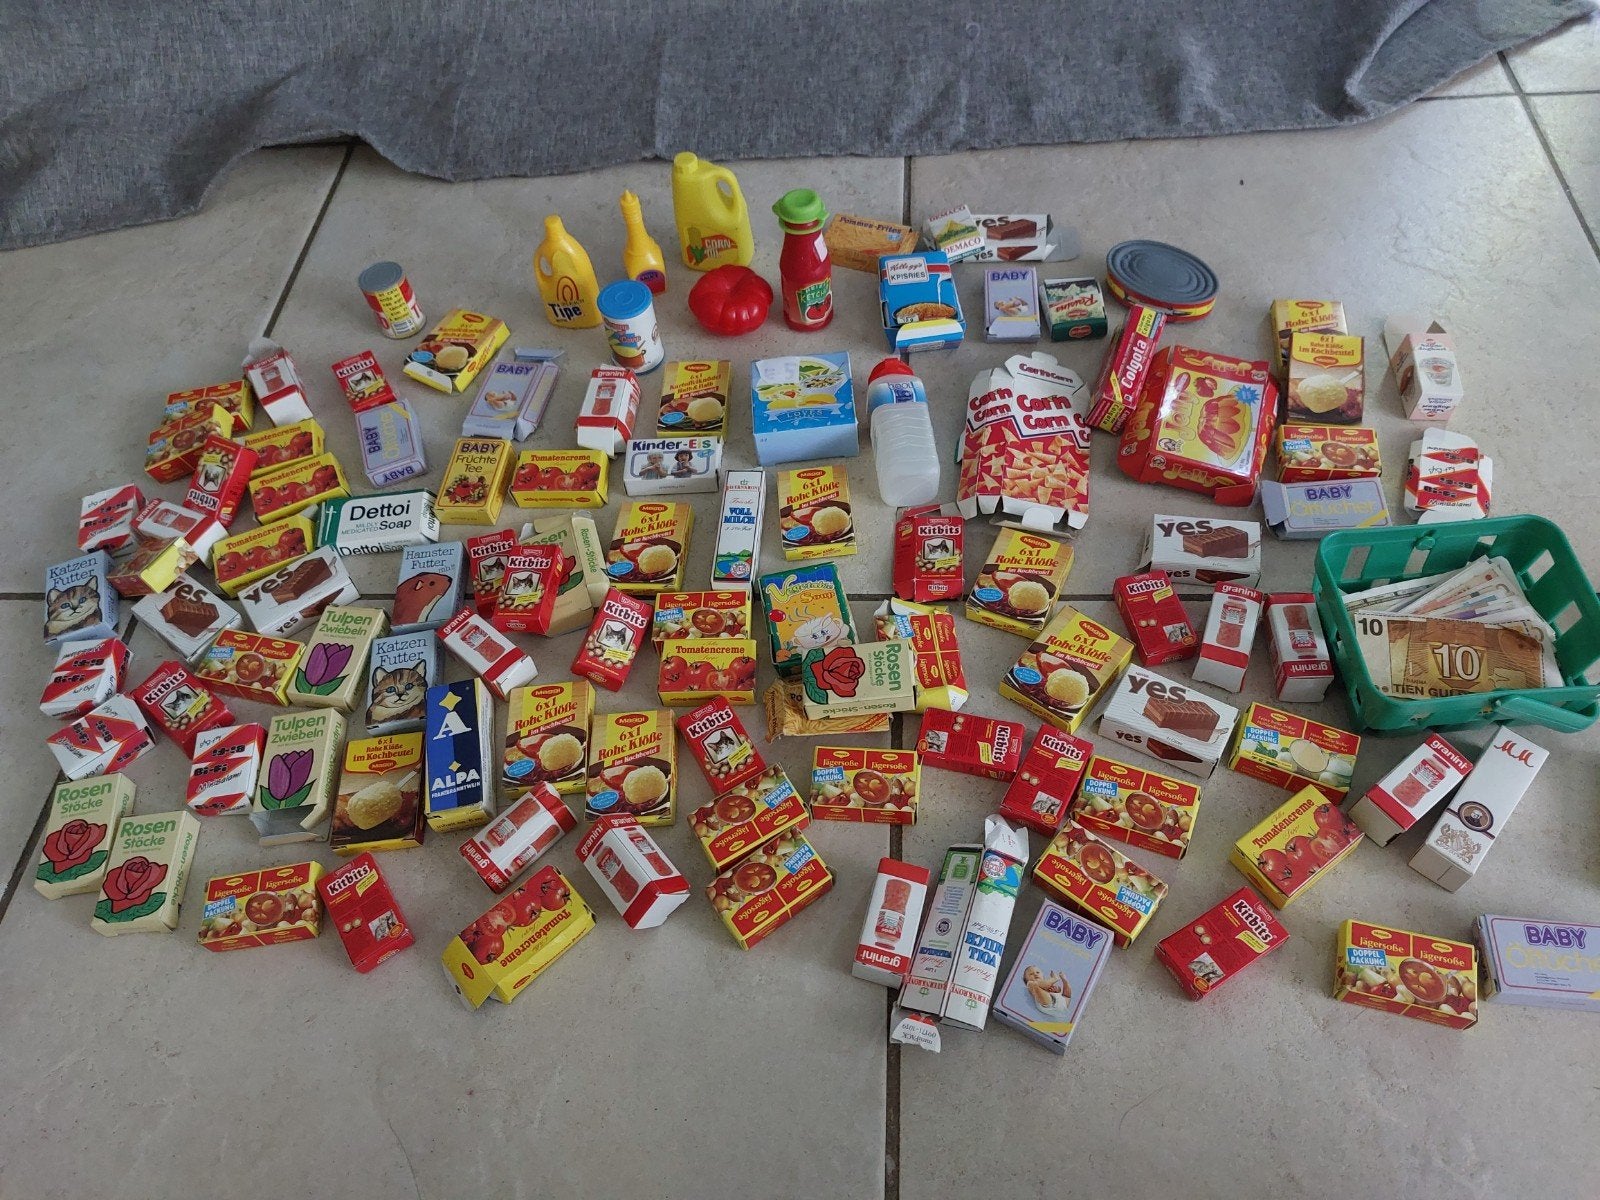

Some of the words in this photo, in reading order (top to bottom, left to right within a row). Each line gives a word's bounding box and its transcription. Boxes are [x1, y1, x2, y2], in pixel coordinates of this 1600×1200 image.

[943, 238, 981, 254] DEMACO
[991, 271, 1028, 281] BABY
[549, 302, 581, 319] Tipe
[337, 359, 374, 377] Kitbits
[496, 365, 533, 376] BABY
[598, 370, 625, 378] granini
[970, 388, 1013, 410] Corn
[1017, 394, 1071, 413] Corn
[974, 404, 1011, 422] Corn
[1023, 414, 1070, 430] Corn
[363, 424, 381, 454] BABY
[632, 439, 712, 451] Kinder-Eis
[461, 443, 500, 453] BABY
[455, 454, 497, 465] Früchte
[531, 454, 590, 462] Tomatencreme
[259, 459, 321, 486] Tomatencreme
[383, 465, 415, 483] BABY
[464, 464, 482, 473] Tee
[802, 477, 821, 490] 6x1
[188, 490, 219, 509] Kitbits
[1307, 486, 1351, 500] BABY
[729, 507, 751, 515] VOLL
[341, 527, 379, 535] MEDICATED
[379, 519, 411, 531] Soap
[640, 514, 660, 525] 6x1
[724, 515, 755, 524] MILCH
[226, 522, 290, 550] Tomatencreme
[620, 525, 646, 538] Rohe
[918, 525, 961, 535] Kitbits
[1157, 520, 1214, 537] yes
[405, 546, 455, 560] Hamster
[471, 541, 514, 557] Kitbits
[581, 528, 597, 573] Rosen-Stöcke
[1019, 547, 1041, 557] 6x1
[50, 557, 98, 579] Katzen
[412, 557, 446, 569] Futter
[508, 557, 551, 569] Kitbits
[995, 554, 1022, 566] Rohe
[1025, 557, 1060, 568] Klöße
[51, 568, 95, 588] Futter
[244, 566, 293, 604] yes
[1127, 579, 1165, 595] Kitbits
[1222, 584, 1257, 598] granini
[324, 610, 372, 627] Tulpen
[443, 609, 470, 634] granini
[605, 601, 647, 627] Kitbits
[276, 616, 299, 633] yes
[318, 623, 367, 636] Zwiebeln
[1358, 617, 1384, 637] 10
[376, 637, 427, 654] Katzen
[1072, 633, 1097, 647] 6x1
[675, 645, 745, 655] Tomatencreme
[1045, 635, 1077, 654] Rohe
[1077, 645, 1113, 663] Klöße
[379, 650, 424, 667] Futter
[1292, 661, 1328, 672] granini
[1432, 644, 1481, 681] 10
[872, 651, 885, 687] Stöcke
[886, 643, 902, 692] Rosen
[144, 670, 187, 704] Kitbits
[535, 688, 561, 697] Maggi
[1126, 673, 1188, 702] yes
[1393, 684, 1425, 695] TIEN
[535, 697, 556, 712] 6x1
[274, 715, 326, 733] Tulpen
[514, 714, 542, 731] Rohe
[545, 701, 578, 720] Klöße
[618, 716, 646, 725] Maggi
[688, 709, 732, 736] Kitbits
[433, 711, 472, 740] A
[619, 726, 641, 741] 6x1
[1250, 728, 1274, 737] DOPPEL
[271, 729, 324, 744] Zwiebeln
[994, 726, 1010, 762] Kitbits
[1115, 730, 1142, 744] yes
[1247, 732, 1278, 744] PACKUNG
[599, 743, 627, 760] Rohe
[629, 731, 663, 749] Klöße
[1041, 735, 1083, 760] Kitbits
[353, 754, 365, 762] im
[367, 748, 414, 760] Kochbeutel
[1430, 739, 1468, 771] granini
[823, 759, 859, 768] Jägersoße
[871, 762, 908, 770] Jägersoße
[432, 768, 480, 791] ALPA
[814, 773, 842, 781] PACKUNG
[1089, 780, 1113, 789] DOPPEL
[1098, 770, 1136, 787] Jägersoße
[57, 781, 112, 803] Rosen
[1086, 785, 1116, 795] PACKUNG
[1149, 786, 1188, 802] Jägersoße
[61, 797, 103, 813] Stöcke
[120, 819, 176, 838] Rosen
[1252, 797, 1315, 848] Tomatencreme
[123, 836, 165, 849] Stöcke
[581, 825, 603, 855] granini
[329, 864, 370, 895] Kitbits
[1051, 858, 1087, 886] Jägersoße
[265, 876, 303, 890] Jägersoße
[214, 885, 252, 898] Jägersoße
[205, 903, 235, 918] PACKUNG
[1097, 890, 1134, 918] Jägersoße
[1046, 910, 1101, 948] BABY
[1234, 901, 1273, 942] Kitbits
[500, 909, 572, 967] Tomatencreme
[965, 931, 1004, 952] MILCH
[1525, 925, 1586, 948] BABY
[1353, 949, 1380, 958] DOPPEL
[1360, 937, 1404, 954] Jägersoße
[861, 950, 901, 966] granini
[969, 947, 997, 967] VOLL
[1350, 956, 1385, 966] PACKUNG
[1419, 950, 1465, 966] Jägersoße
